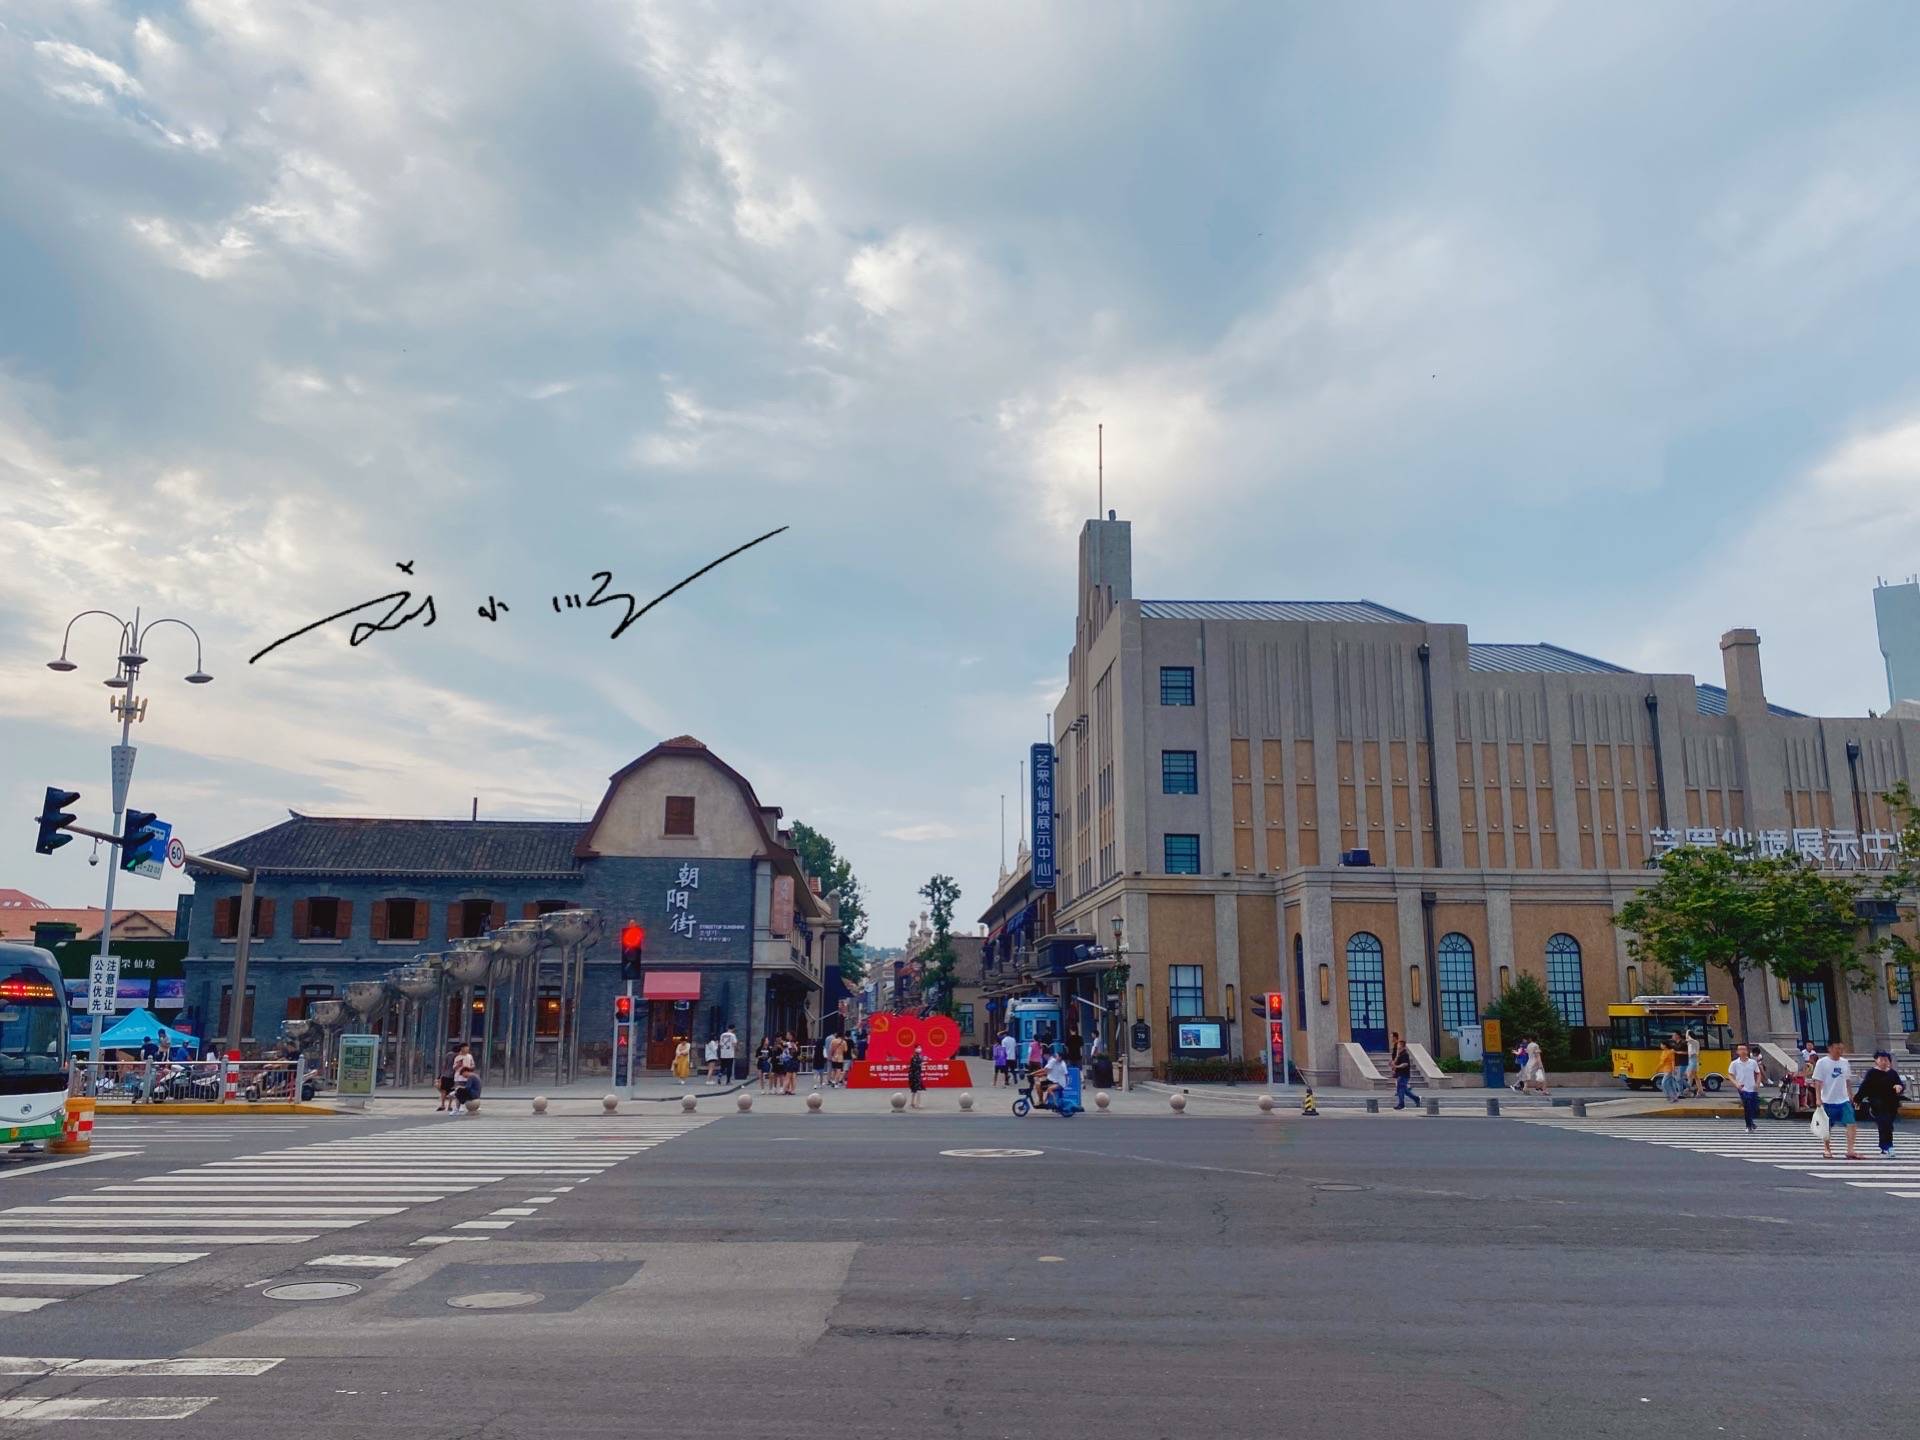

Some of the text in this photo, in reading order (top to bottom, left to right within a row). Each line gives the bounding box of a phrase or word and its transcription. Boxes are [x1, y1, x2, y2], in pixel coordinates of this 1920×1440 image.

[1036, 754, 1051, 877] 芝罘仙境展示中心
[171, 846, 182, 860] 60
[666, 863, 699, 938] 朝阳街
[91, 960, 104, 1011] 公交优先
[103, 960, 117, 1011] 注意避让
